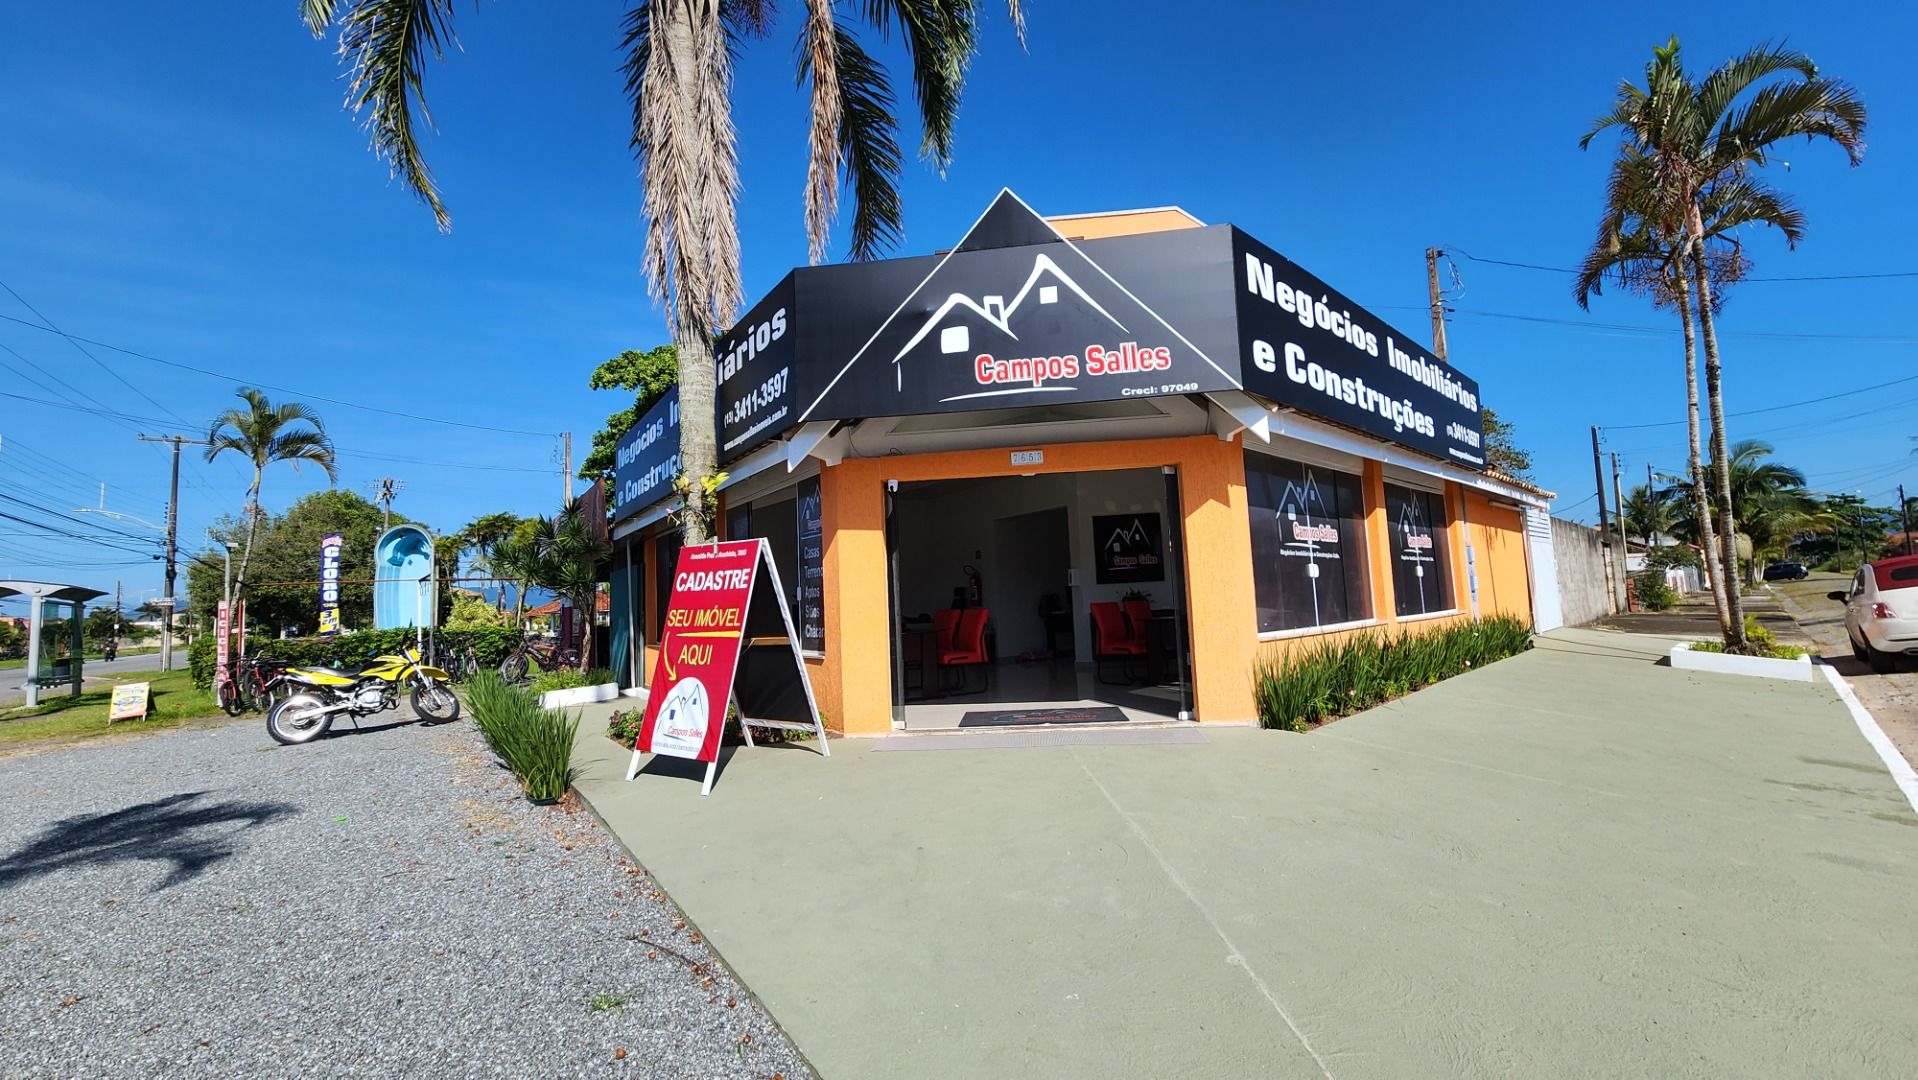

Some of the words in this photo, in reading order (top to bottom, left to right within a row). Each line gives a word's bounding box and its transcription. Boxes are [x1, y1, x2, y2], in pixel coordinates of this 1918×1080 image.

[1245, 252, 1378, 357] Negócios
[1387, 336, 1478, 413] Imobiliários
[975, 354, 1079, 387] Campos
[1086, 342, 1171, 375] Salles
[734, 366, 789, 423] 3411-3597
[1161, 382, 1199, 393] 97049
[1253, 339, 1276, 373] e
[1284, 341, 1435, 438] Construções
[617, 417, 664, 470] Negócios
[618, 487, 624, 507] e
[625, 453, 682, 503] Construç
[676, 568, 751, 592] CADASTRE
[667, 609, 694, 627] SEU
[694, 604, 741, 627] IMÓVEL
[804, 624, 824, 638] Chácar
[677, 644, 713, 666] AQUI
